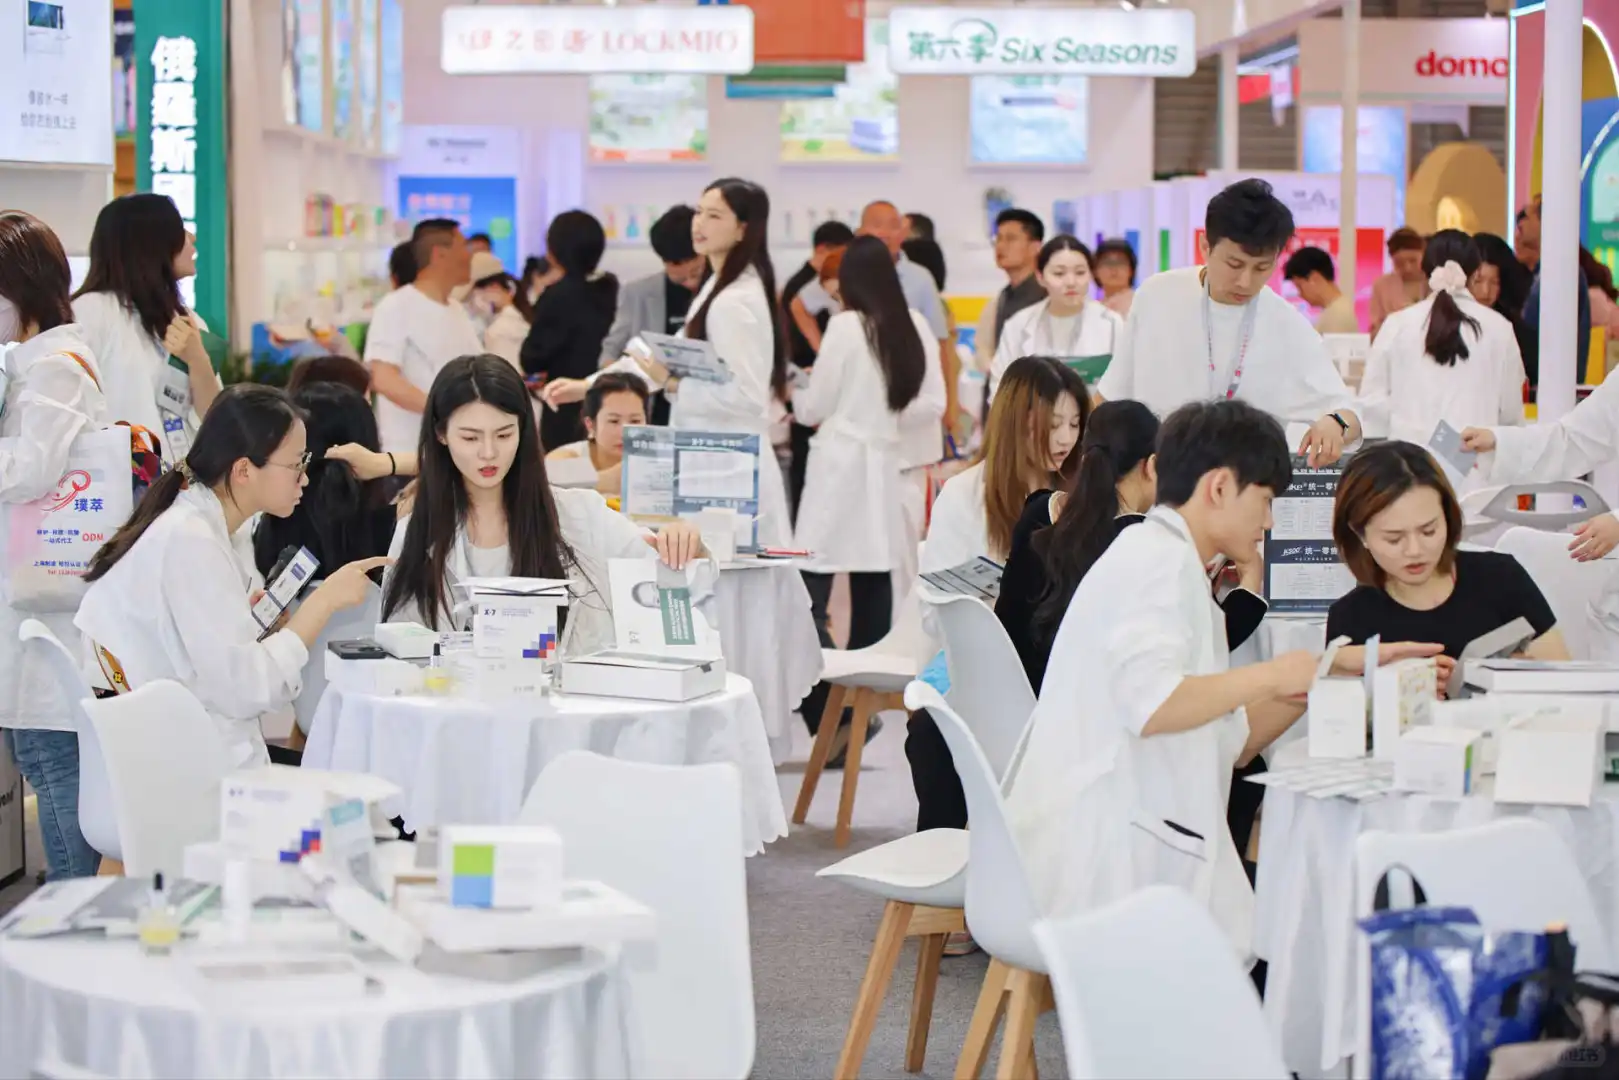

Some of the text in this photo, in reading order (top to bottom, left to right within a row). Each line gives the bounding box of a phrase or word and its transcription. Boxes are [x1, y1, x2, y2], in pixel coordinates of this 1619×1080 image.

[908, 28, 1178, 64] 第六季 Six Seasons
[74, 498, 104, 512] 璞萃
[82, 533, 104, 542] ODM
